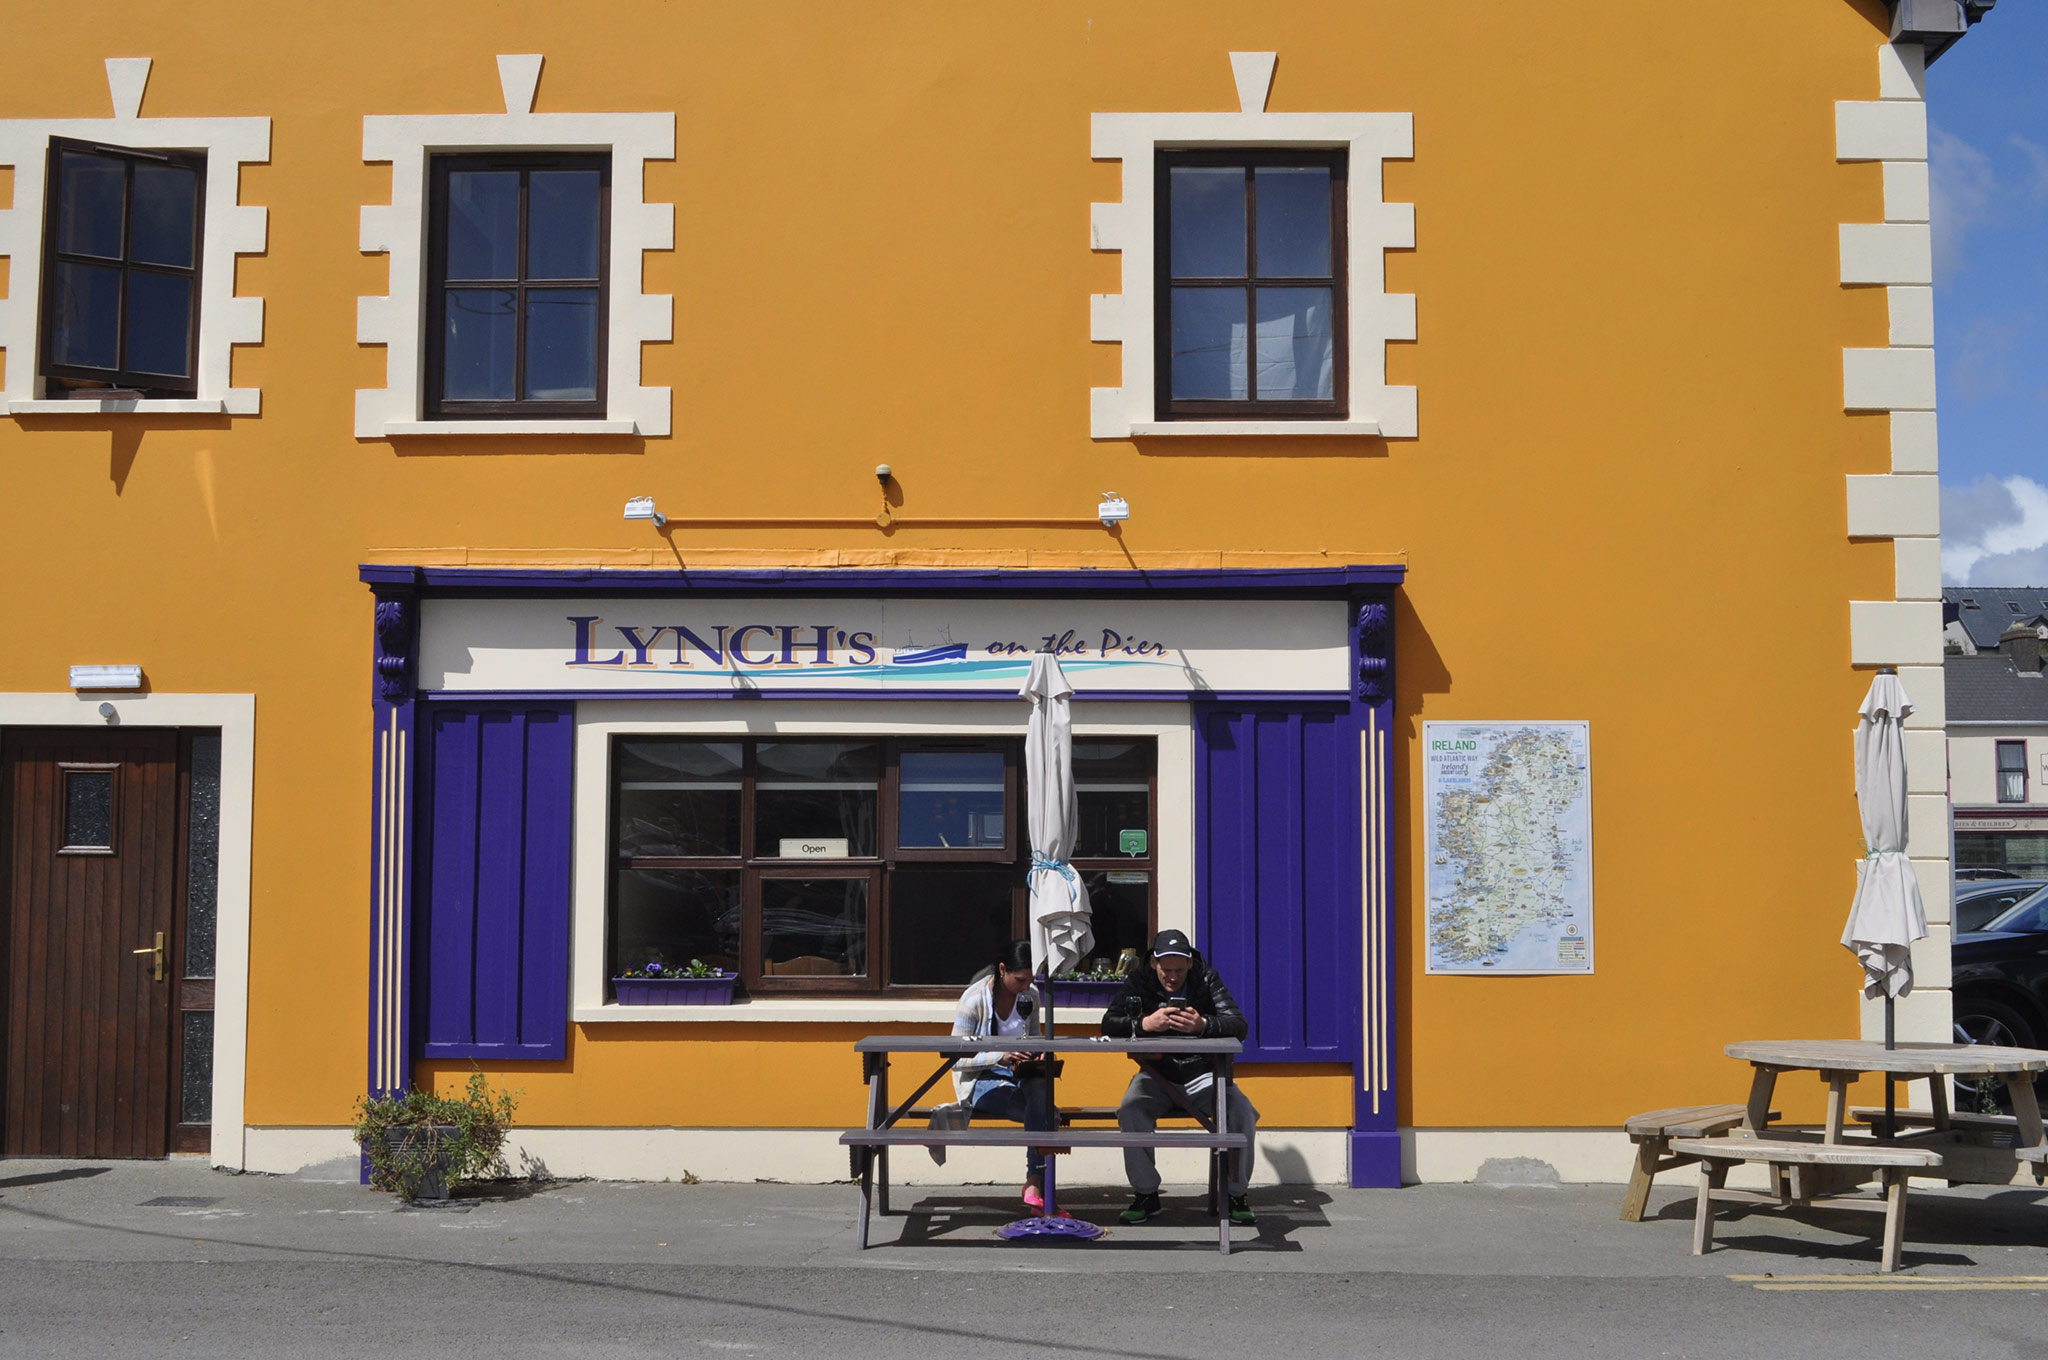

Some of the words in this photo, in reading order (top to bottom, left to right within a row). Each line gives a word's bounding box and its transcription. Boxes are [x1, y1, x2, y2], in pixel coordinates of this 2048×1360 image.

[985, 641, 1029, 656] on
[1041, 628, 1088, 656] the
[1100, 628, 1168, 658] Pier
[1432, 740, 1477, 751] IRELAND
[802, 844, 826, 854] Open
